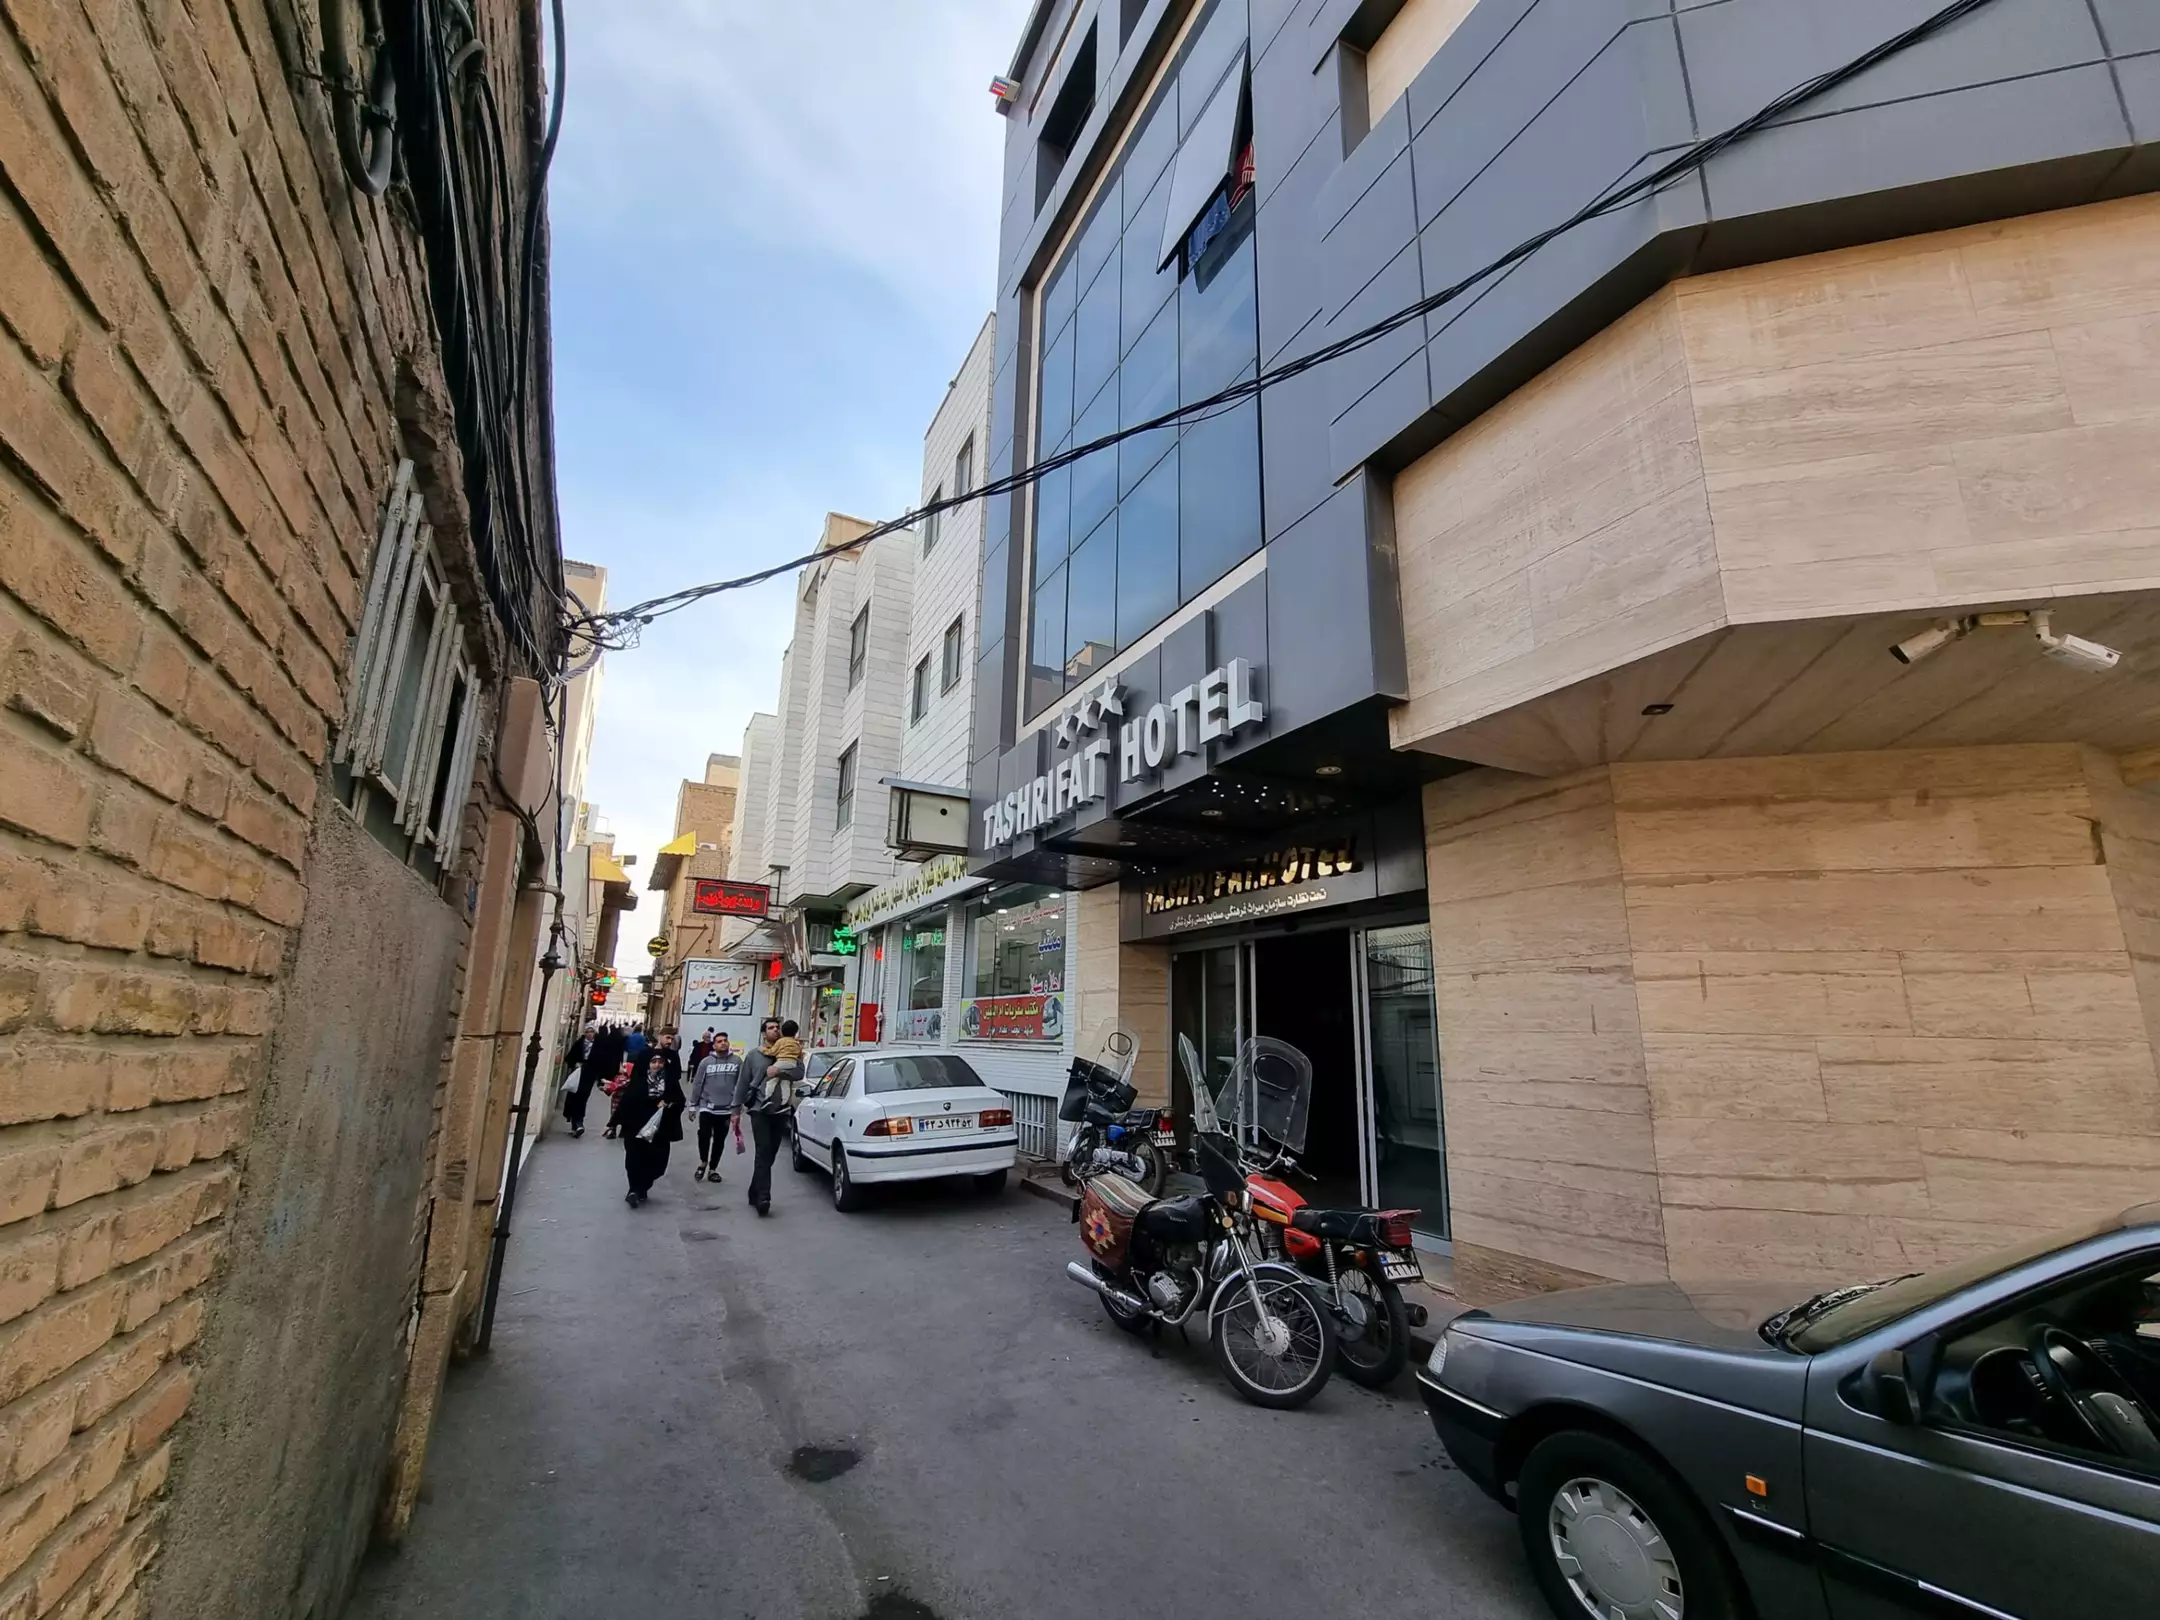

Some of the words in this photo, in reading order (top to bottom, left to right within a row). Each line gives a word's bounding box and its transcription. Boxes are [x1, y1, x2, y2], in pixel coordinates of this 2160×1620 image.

[983, 738, 1111, 851] TASHRIFAT
[1121, 657, 1263, 784] HOTEL
[1224, 902, 1247, 920] فرهنگی
[1264, 898, 1286, 913] سازمان
[702, 988, 741, 1012] کوثر
